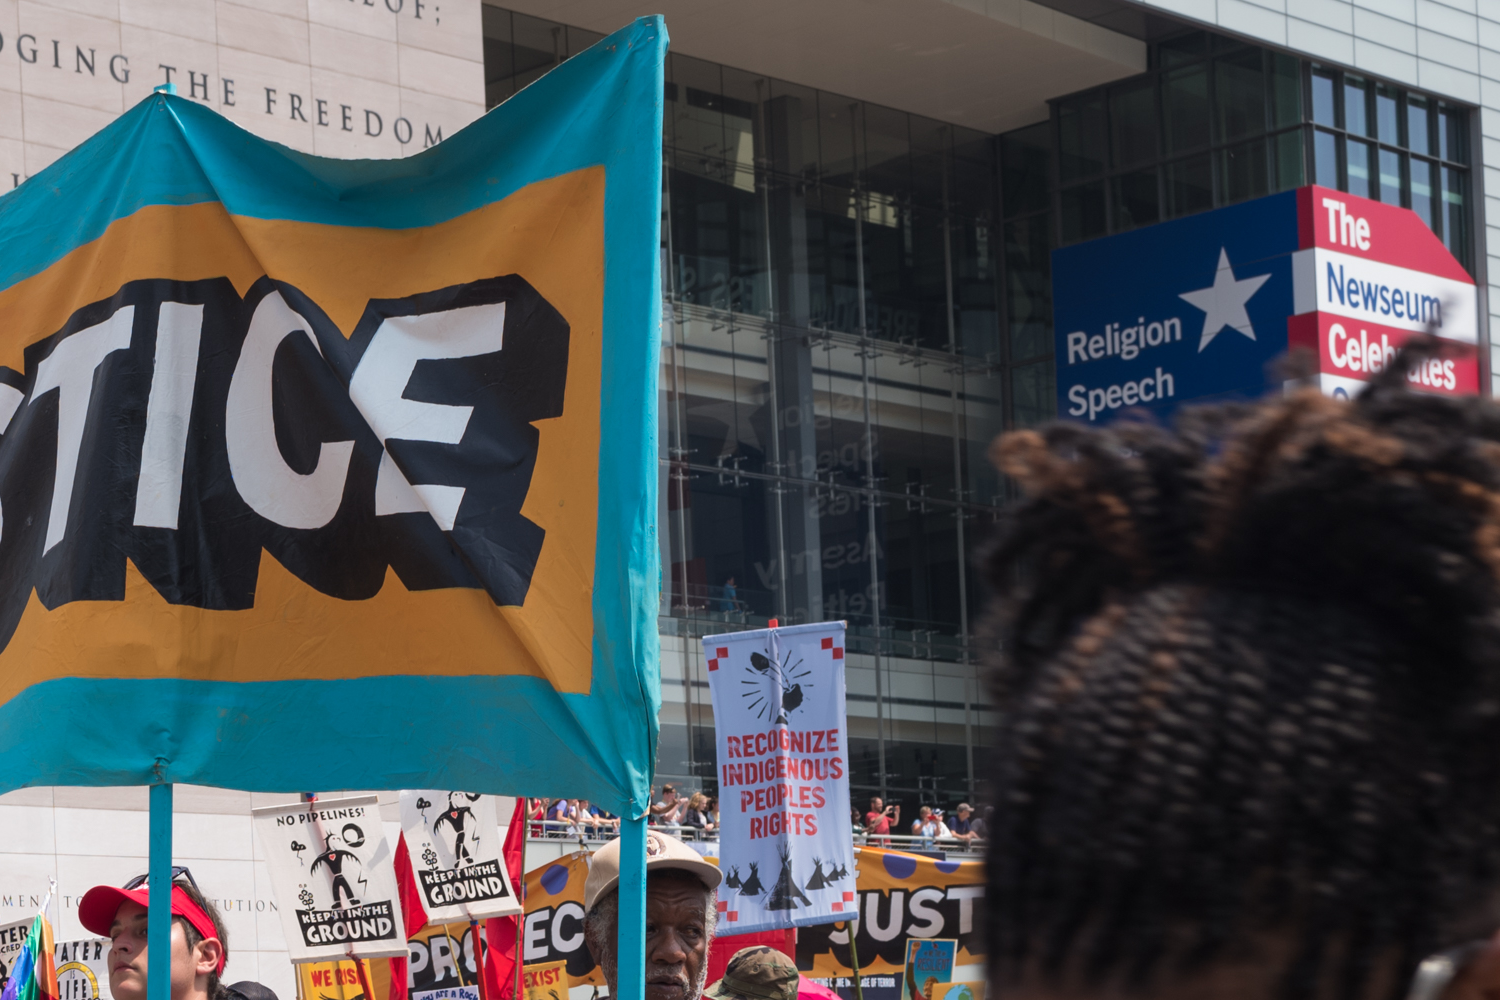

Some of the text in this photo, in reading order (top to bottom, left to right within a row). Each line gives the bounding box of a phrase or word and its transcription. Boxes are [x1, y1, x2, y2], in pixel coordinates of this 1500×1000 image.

[159, 64, 236, 107] THE
[264, 87, 443, 149] FREEDOM
[1323, 197, 1371, 251] The
[1066, 316, 1183, 364] Religion
[1067, 366, 1175, 421] Speech
[726, 728, 840, 759] RECOGNIZE
[722, 756, 844, 787] INDIGENOUS
[740, 786, 826, 813] PEOPLES
[276, 807, 366, 828] NO PIPELINES!
[750, 812, 818, 840] RIGHTS
[424, 869, 454, 885] KEEP
[477, 863, 498, 877] THE
[430, 876, 503, 905] GROUND
[301, 909, 335, 925] KEEP
[364, 903, 390, 917] THE
[306, 917, 393, 944] GROUND
[58, 978, 88, 1000] LIFE
[311, 969, 333, 988] WE
[524, 966, 561, 990] EXIST
[878, 977, 896, 988] TERROR
[451, 989, 457, 998] A
